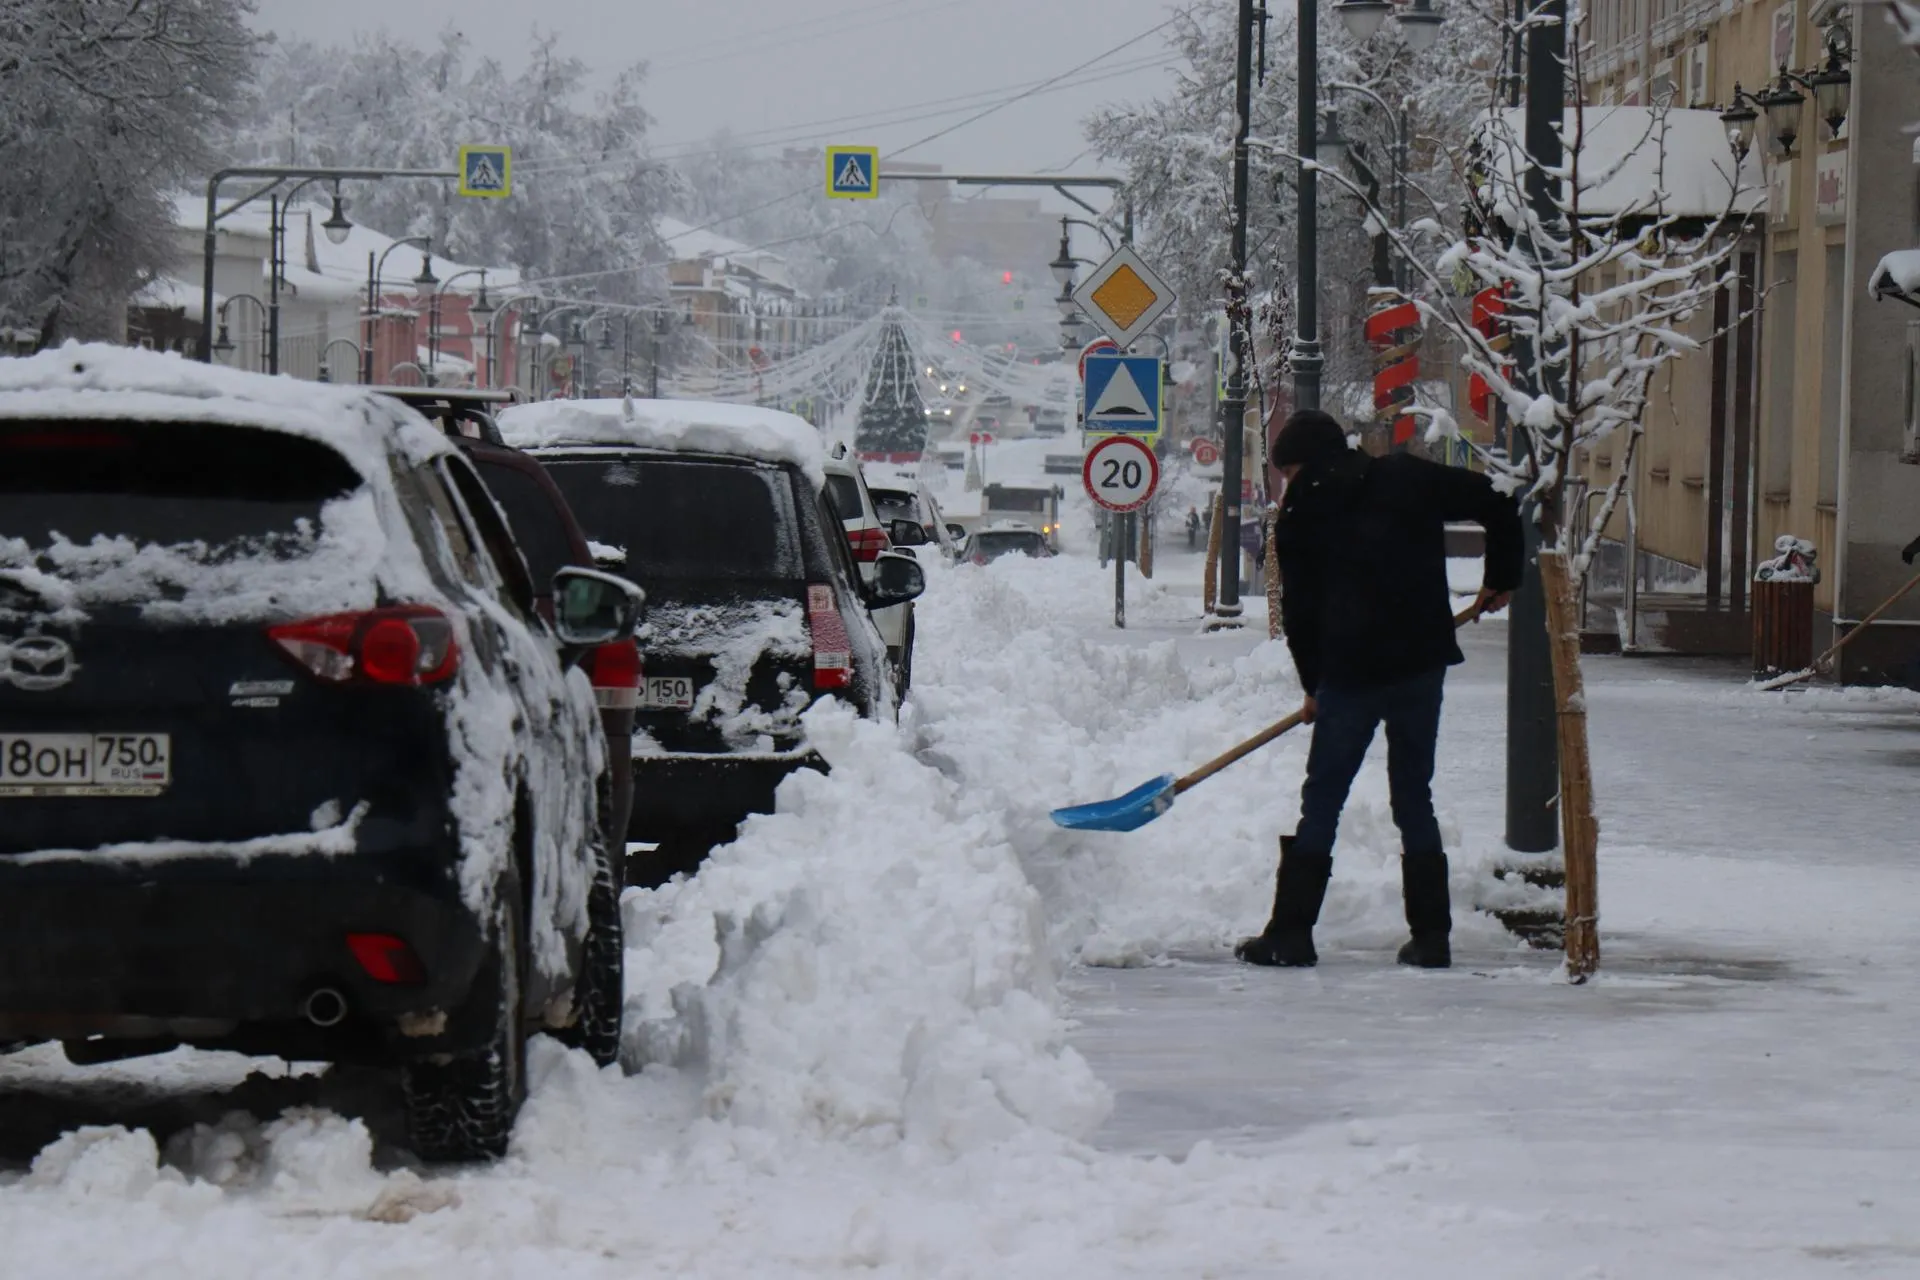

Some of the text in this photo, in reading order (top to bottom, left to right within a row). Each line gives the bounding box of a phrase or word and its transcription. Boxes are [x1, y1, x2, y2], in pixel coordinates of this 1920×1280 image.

[1101, 459, 1142, 490] 20
[651, 680, 686, 697] 150
[97, 737, 158, 766] 750
[111, 768, 141, 779] RUS
